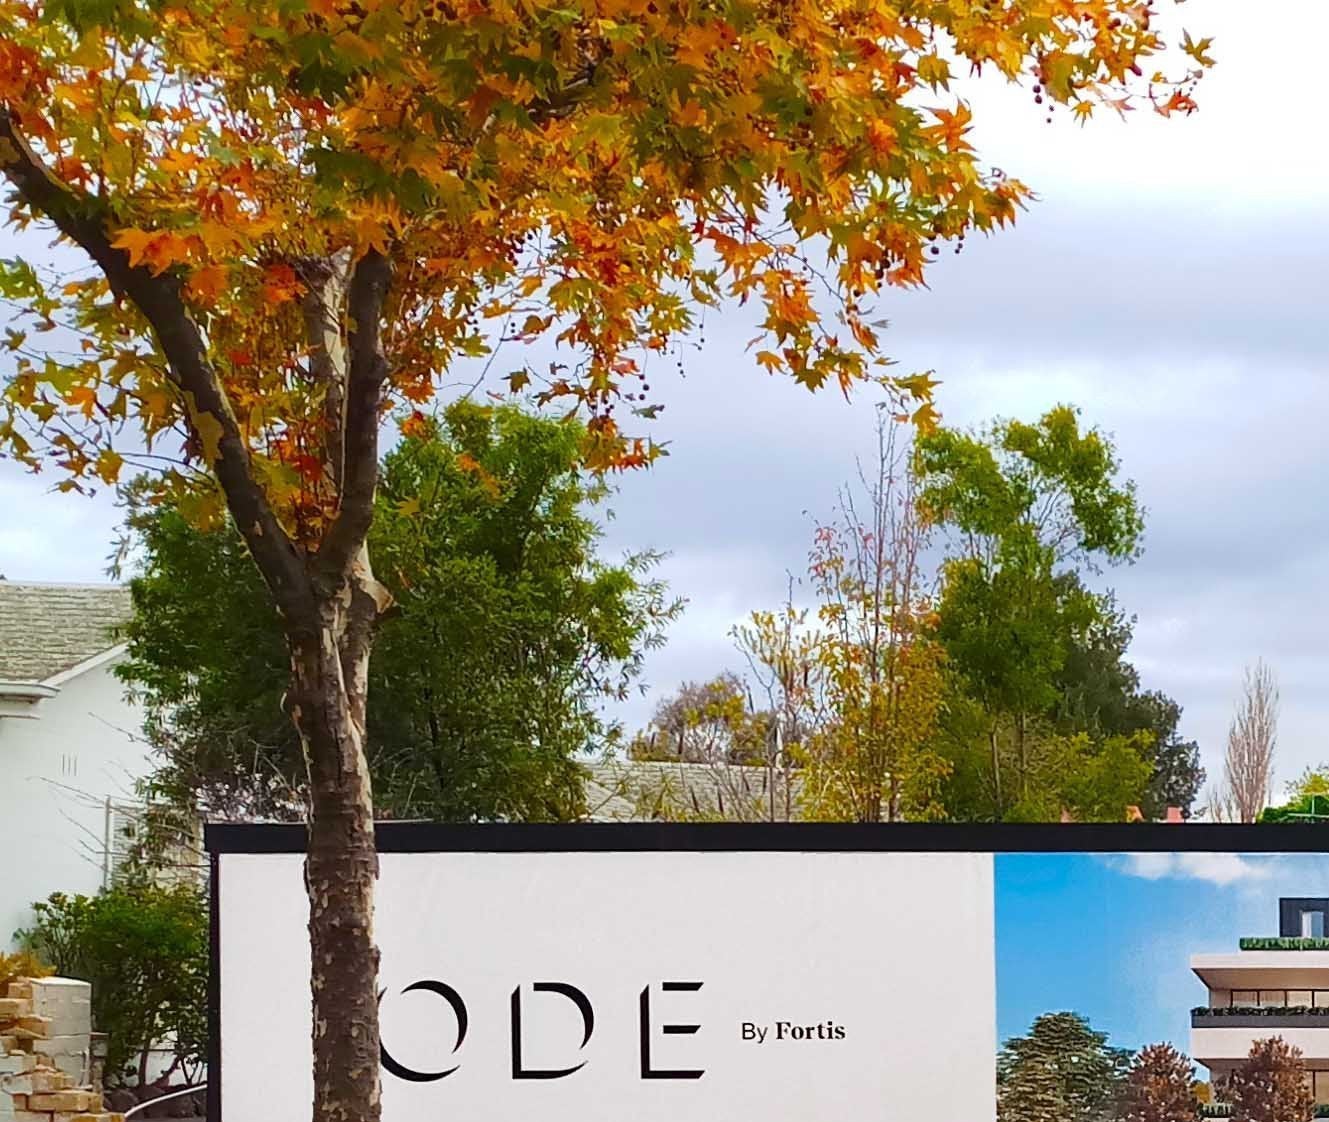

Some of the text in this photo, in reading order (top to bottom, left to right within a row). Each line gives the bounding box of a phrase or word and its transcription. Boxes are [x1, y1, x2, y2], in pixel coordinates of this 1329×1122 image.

[378, 980, 706, 1083] ODE
[741, 1020, 846, 1044] By Fortis
